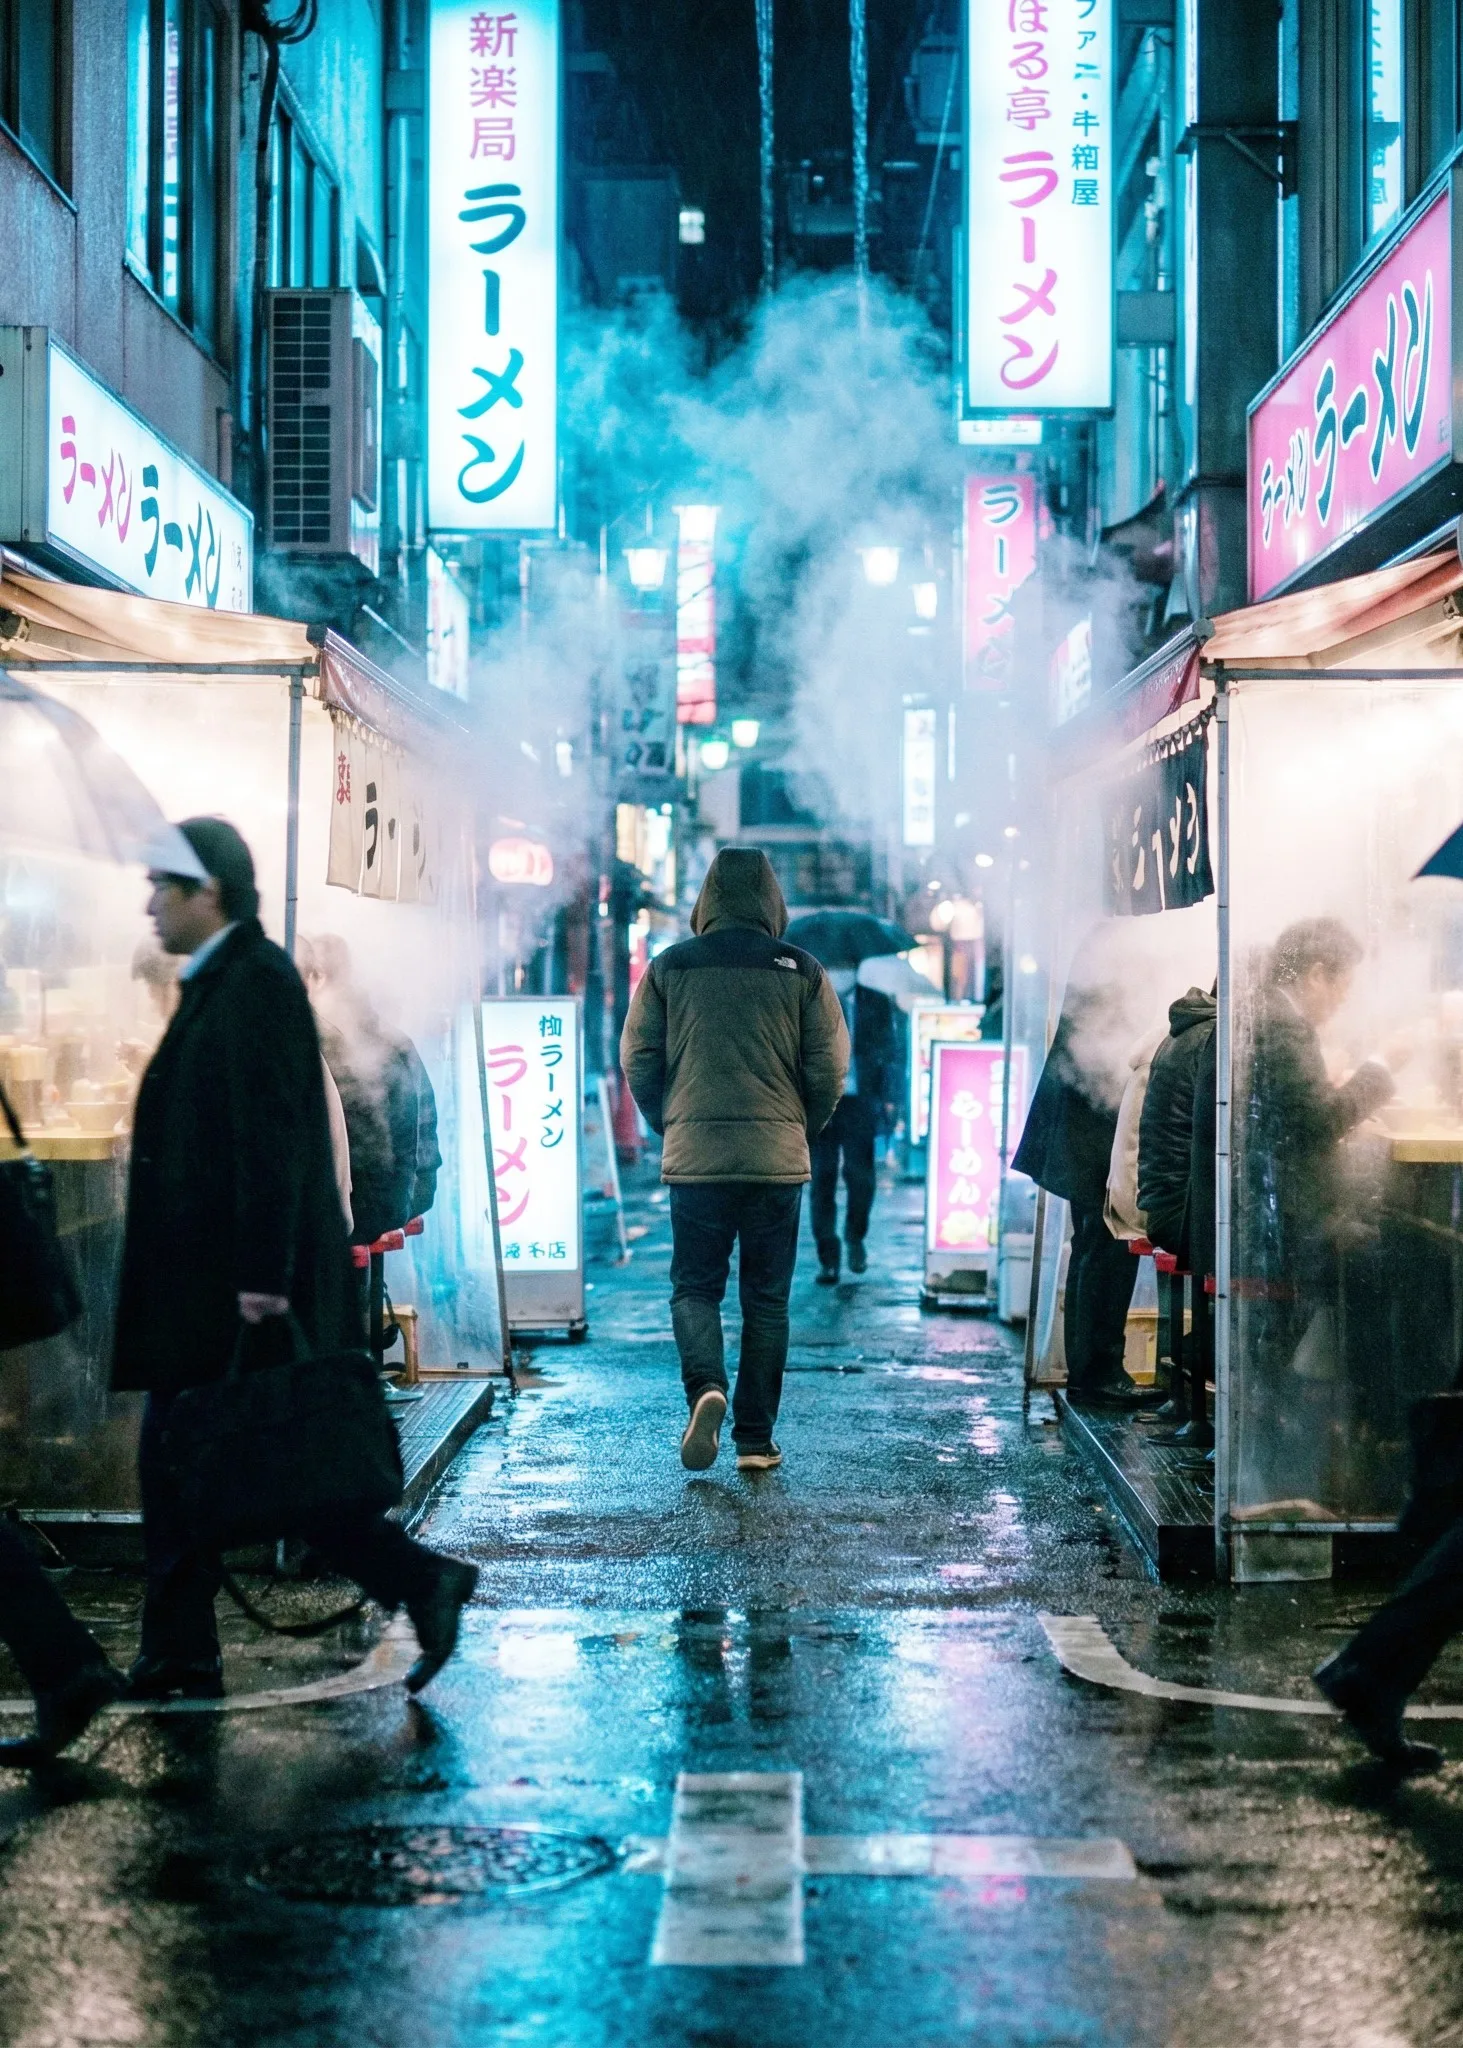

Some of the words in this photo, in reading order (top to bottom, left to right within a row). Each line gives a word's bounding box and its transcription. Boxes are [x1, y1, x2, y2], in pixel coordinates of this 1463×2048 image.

[469, 11, 519, 161] 新楽局
[457, 183, 527, 504] ラーメン
[998, 150, 1060, 391] ラーメン
[59, 414, 133, 544] ラーメン
[1312, 268, 1434, 528] ラーメン
[139, 463, 222, 612] ラーメン
[1261, 427, 1310, 549] ラーメン
[486, 1043, 530, 1227] ラーメン
